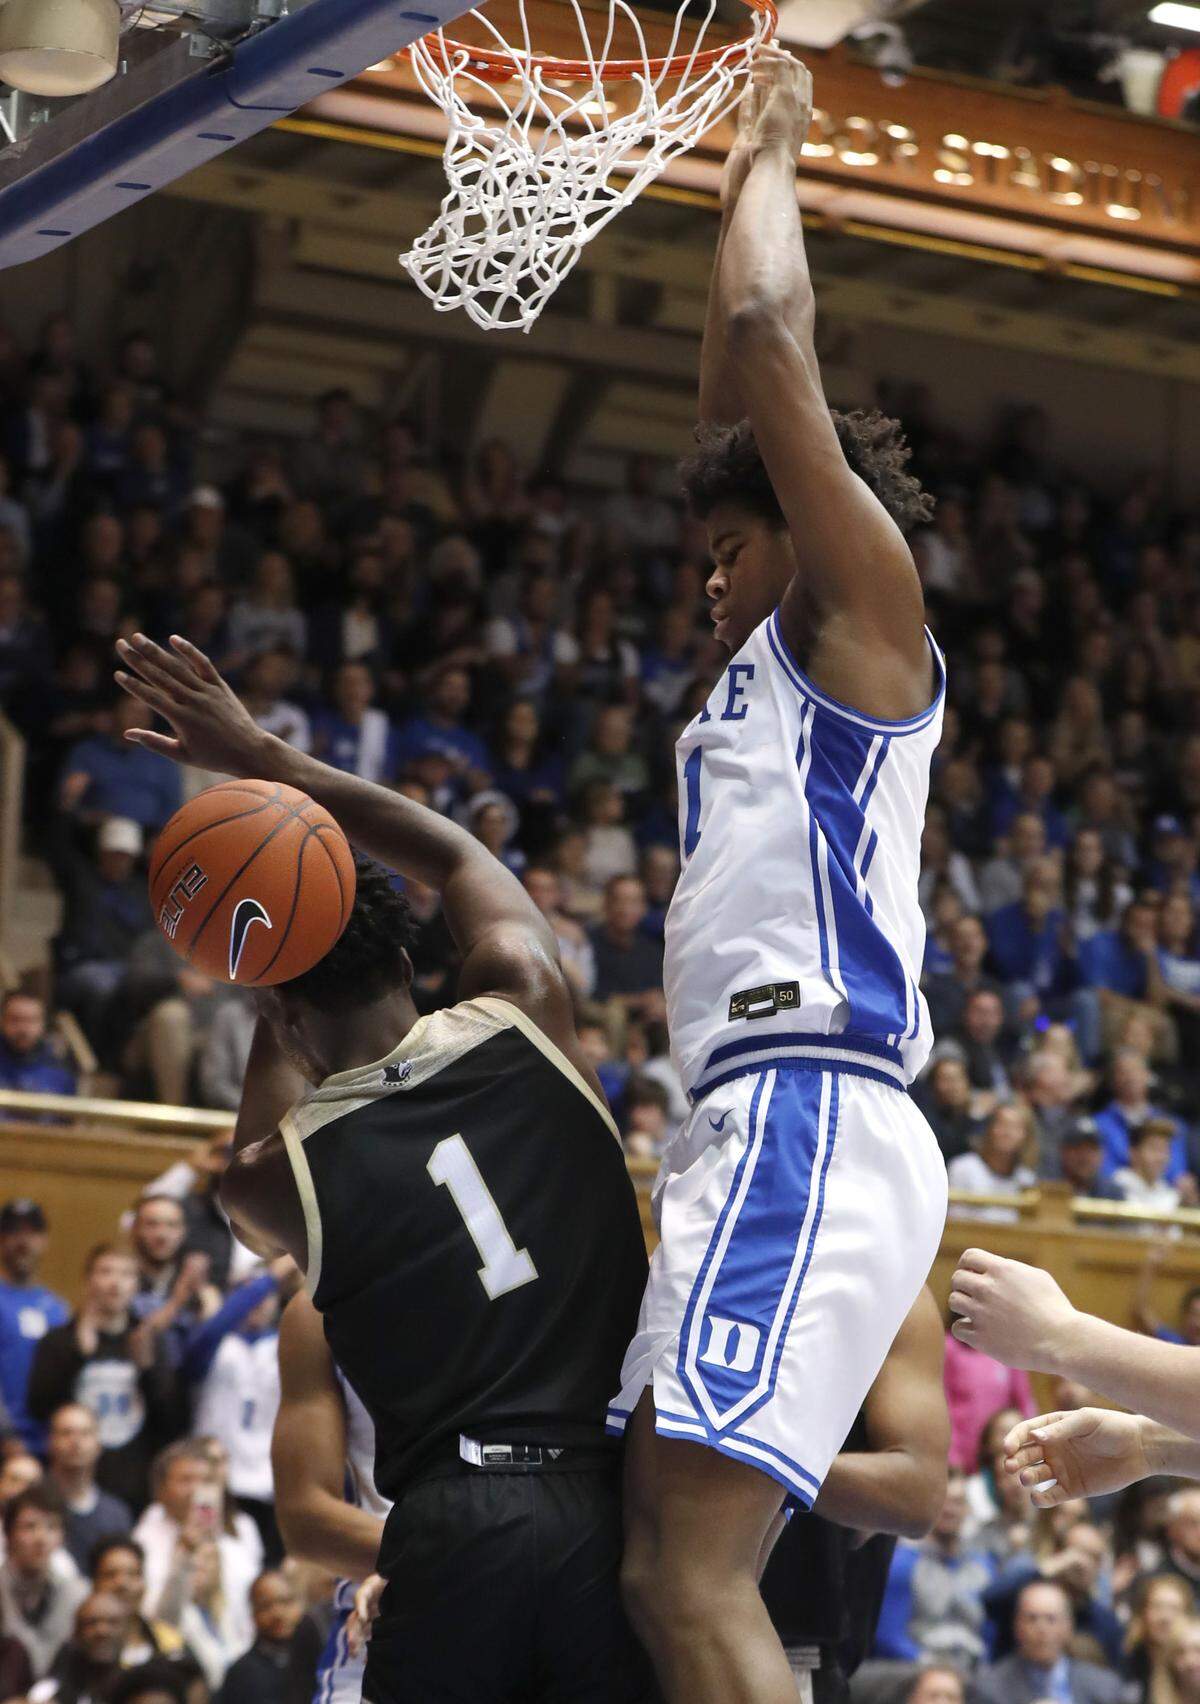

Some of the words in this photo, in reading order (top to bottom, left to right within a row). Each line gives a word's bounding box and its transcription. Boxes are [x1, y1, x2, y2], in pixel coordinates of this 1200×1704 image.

[684, 745, 702, 860] 1
[158, 864, 208, 940] ELITE
[779, 990, 793, 1002] 50
[425, 1132, 540, 1302] 1
[699, 1315, 761, 1373] D
